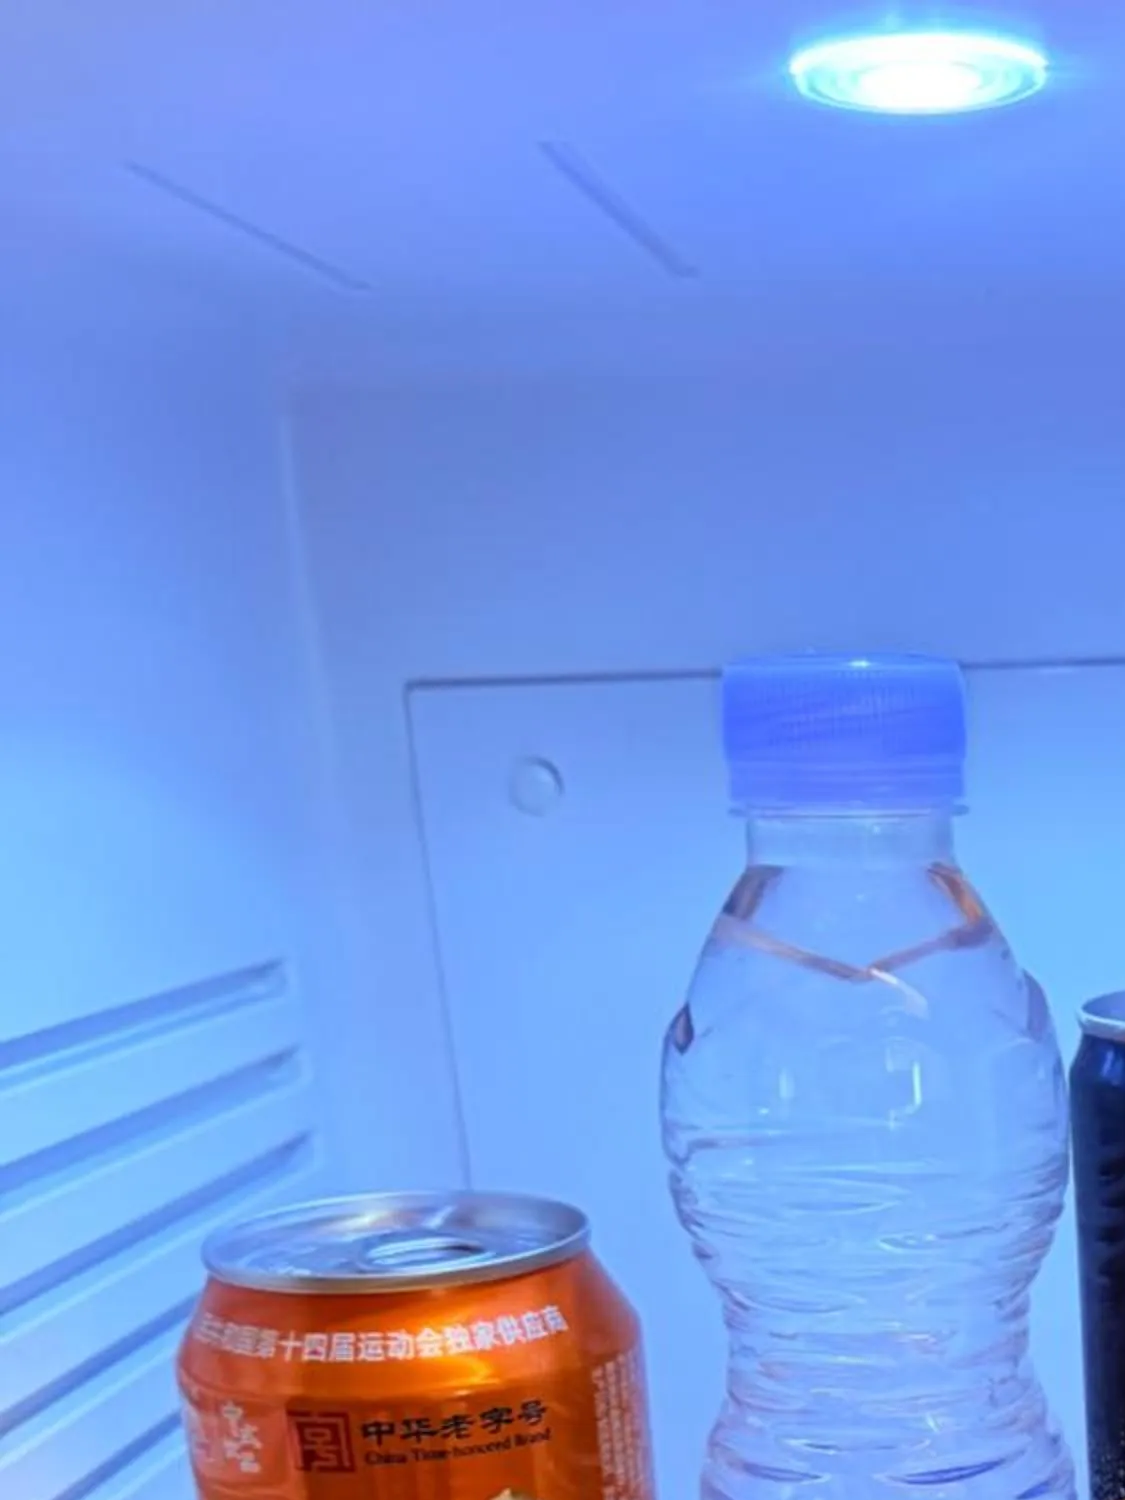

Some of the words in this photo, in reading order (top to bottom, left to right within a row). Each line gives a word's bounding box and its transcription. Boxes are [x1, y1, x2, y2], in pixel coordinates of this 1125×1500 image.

[362, 1400, 547, 1447] 中华老字号
[365, 1451, 408, 1465] China
[515, 1428, 552, 1448] Brand
